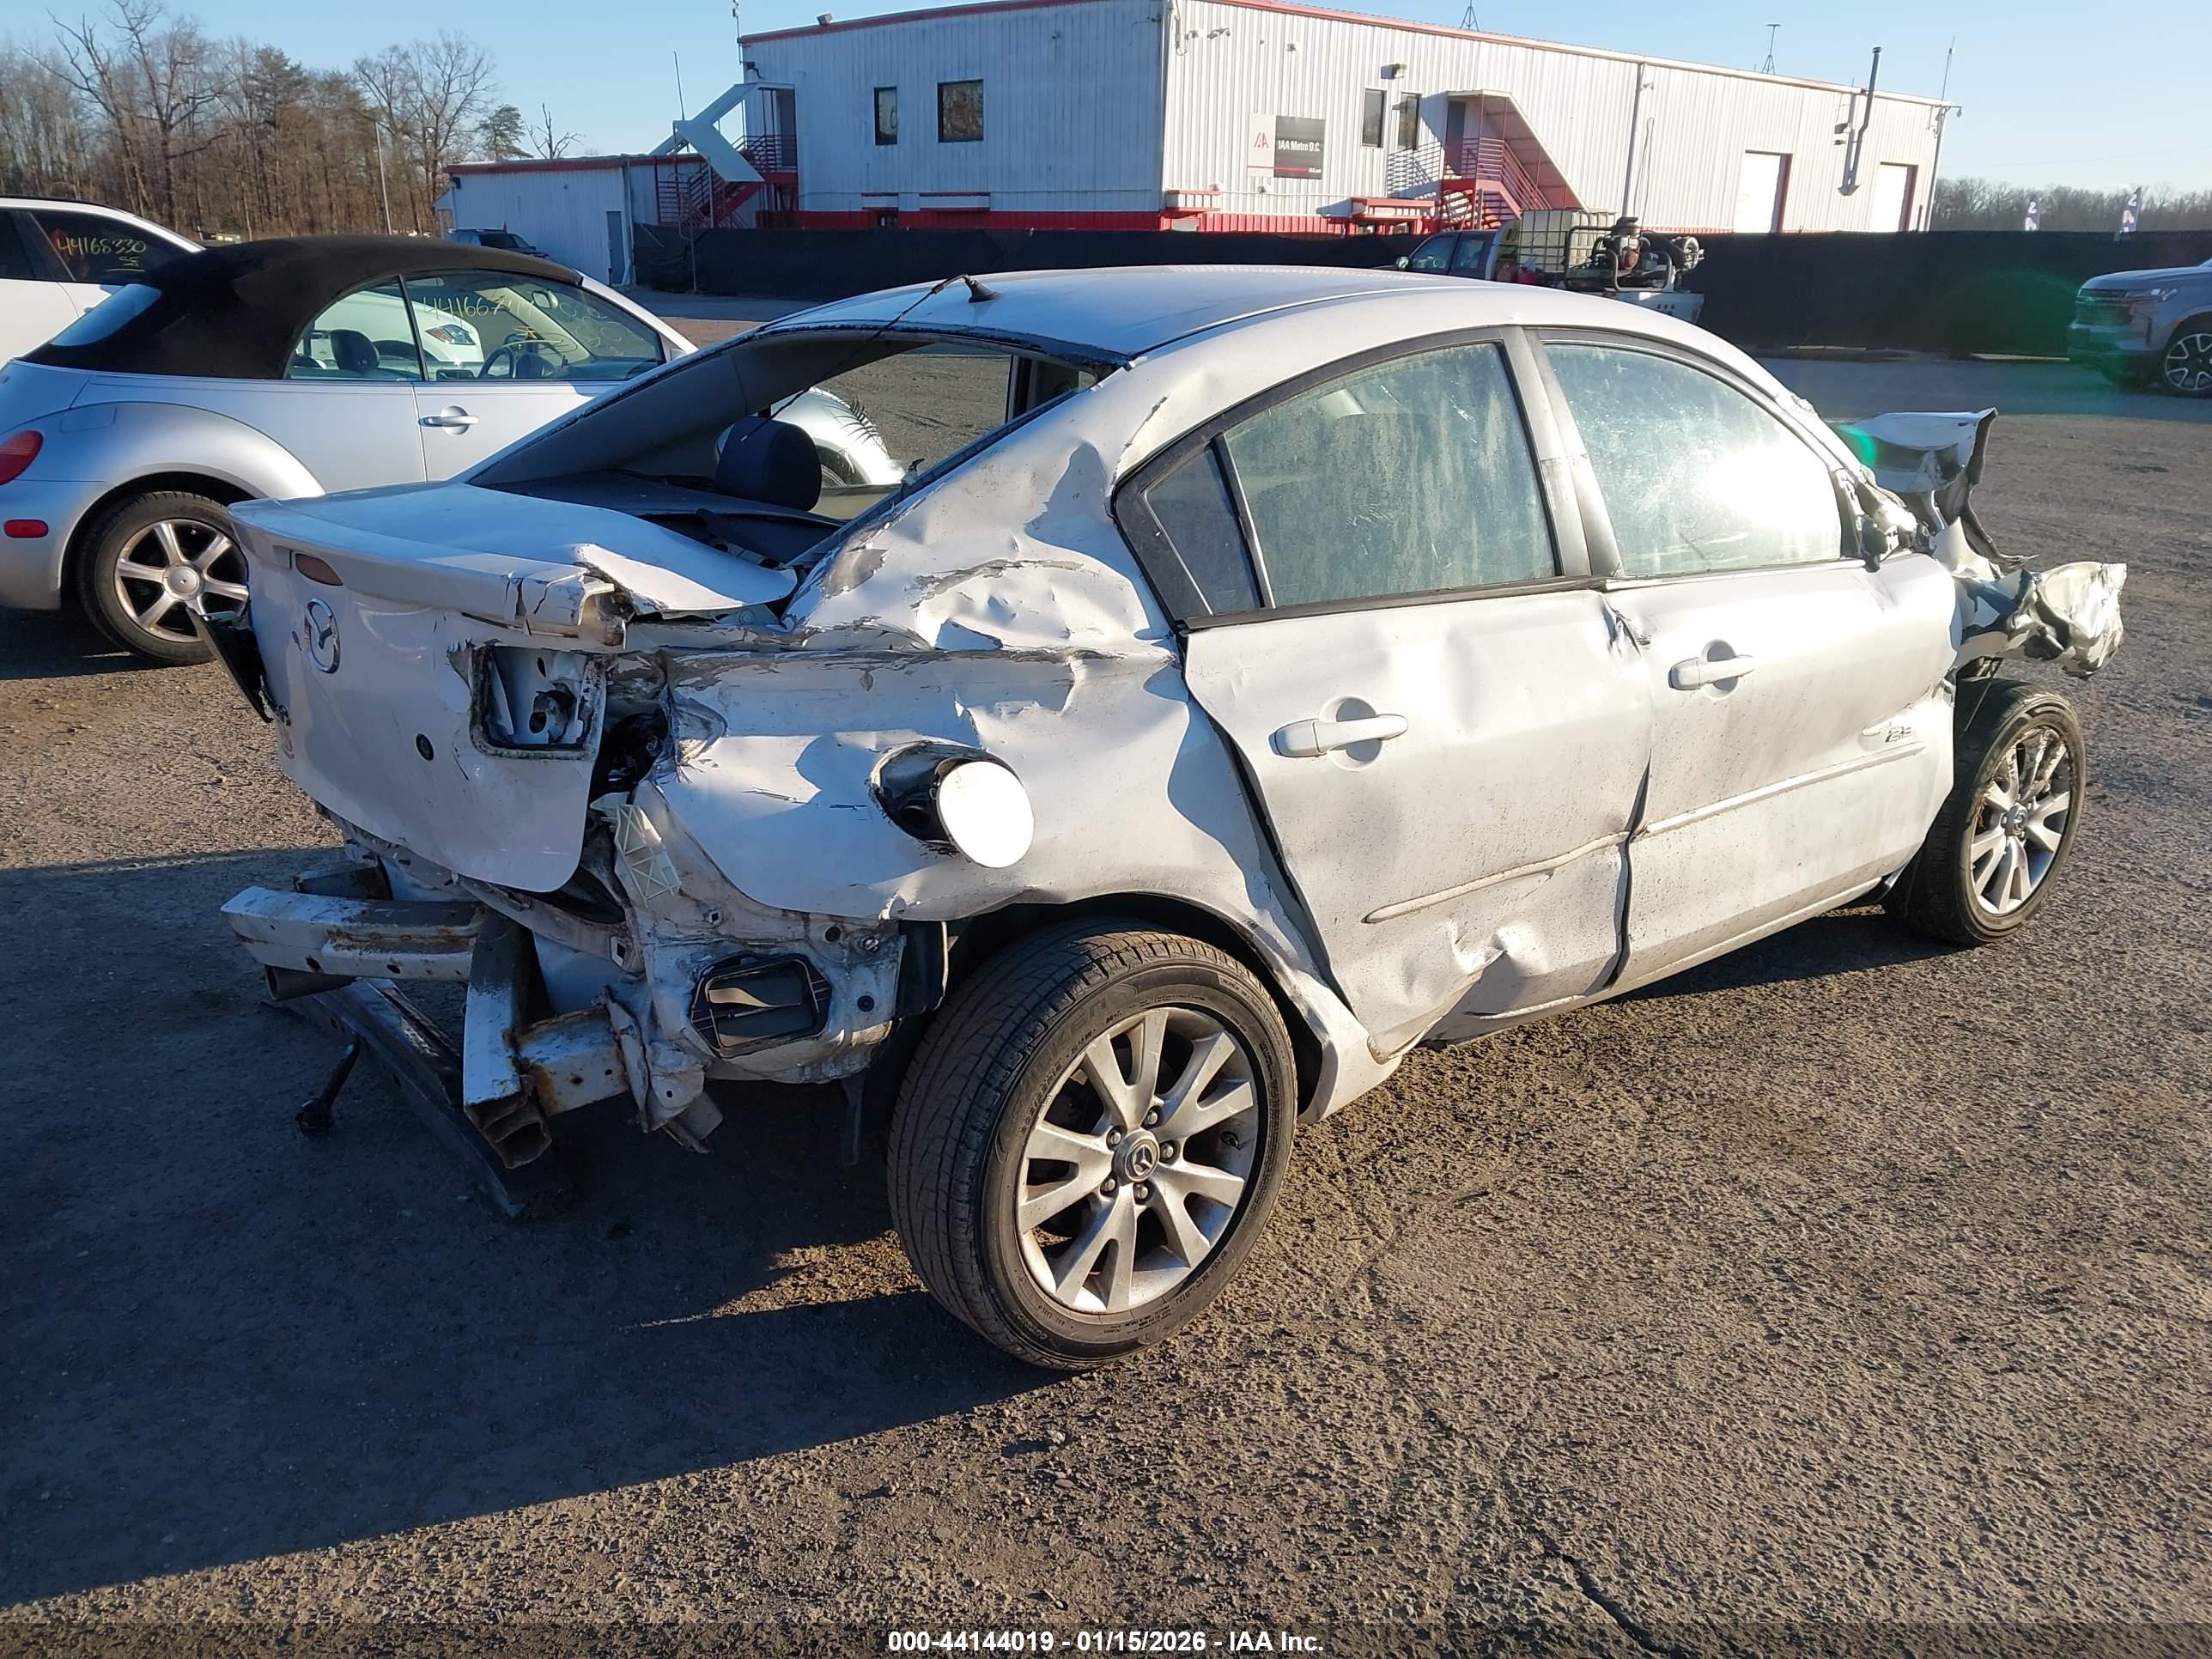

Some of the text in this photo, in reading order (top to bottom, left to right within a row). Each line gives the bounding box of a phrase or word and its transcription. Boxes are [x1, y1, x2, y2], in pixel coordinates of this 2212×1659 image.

[1278, 139, 1322, 152] IAA Metro D.C.
